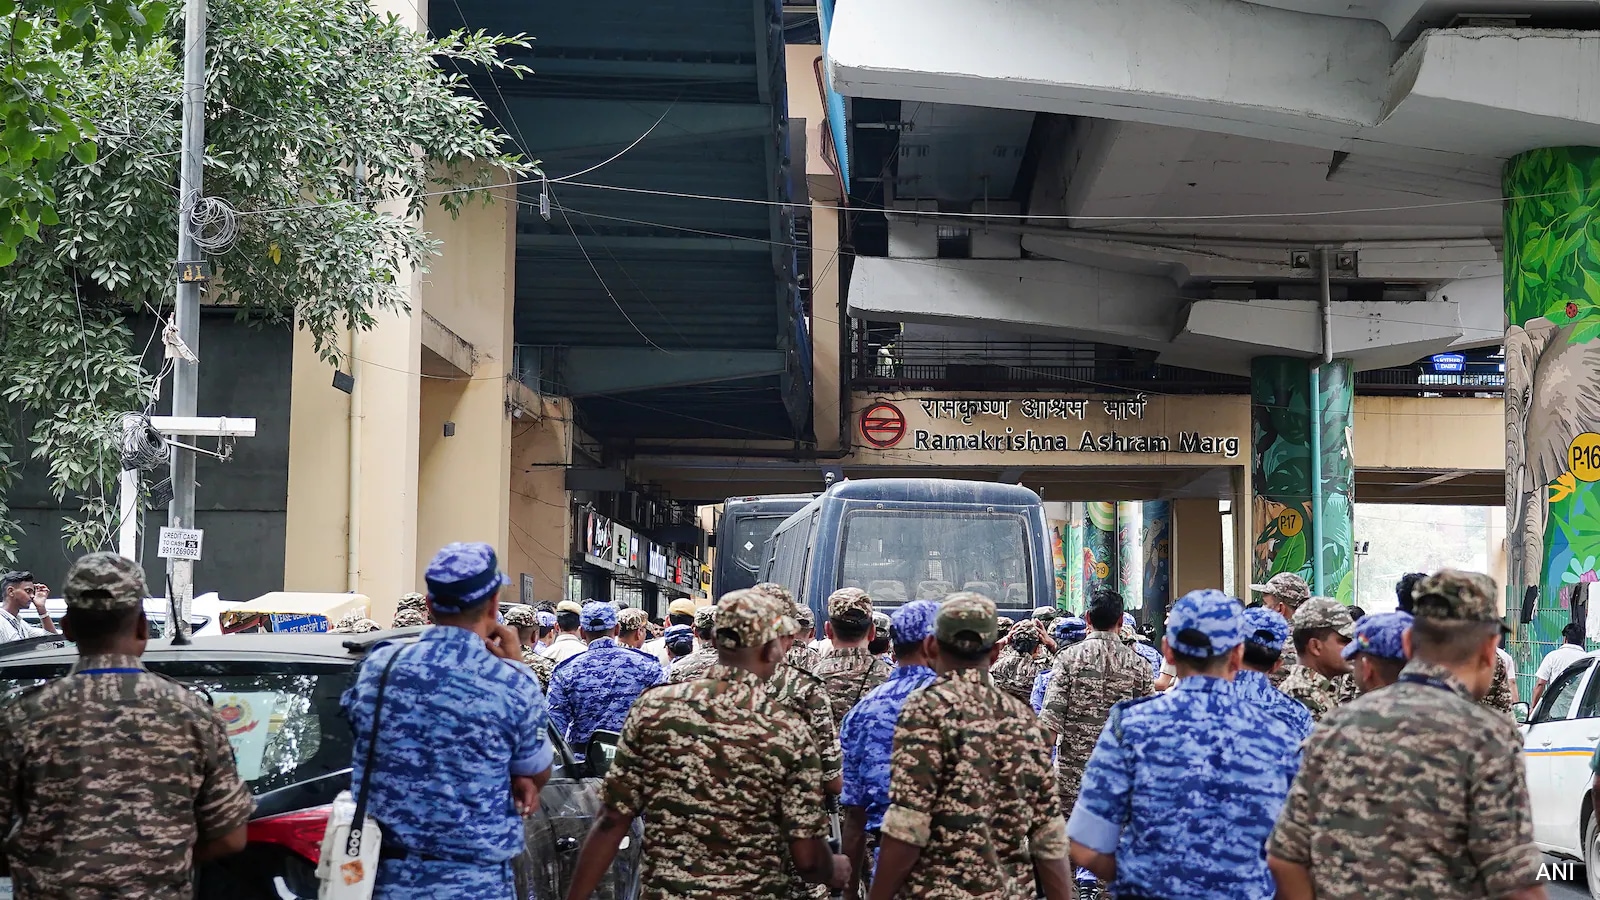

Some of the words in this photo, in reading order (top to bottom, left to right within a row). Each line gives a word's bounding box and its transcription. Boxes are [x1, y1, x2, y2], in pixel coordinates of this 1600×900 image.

[918, 398, 1011, 425] रामकृष्ण
[1020, 398, 1089, 420] आश्रम
[1103, 392, 1148, 420] मार्ग
[914, 427, 1069, 451] Ramakrishna
[1079, 430, 1171, 452] Ashram
[1178, 430, 1240, 458] Marg
[1573, 445, 1600, 470] P-16
[1280, 514, 1296, 530] P-17
[182, 533, 199, 541] CARD
